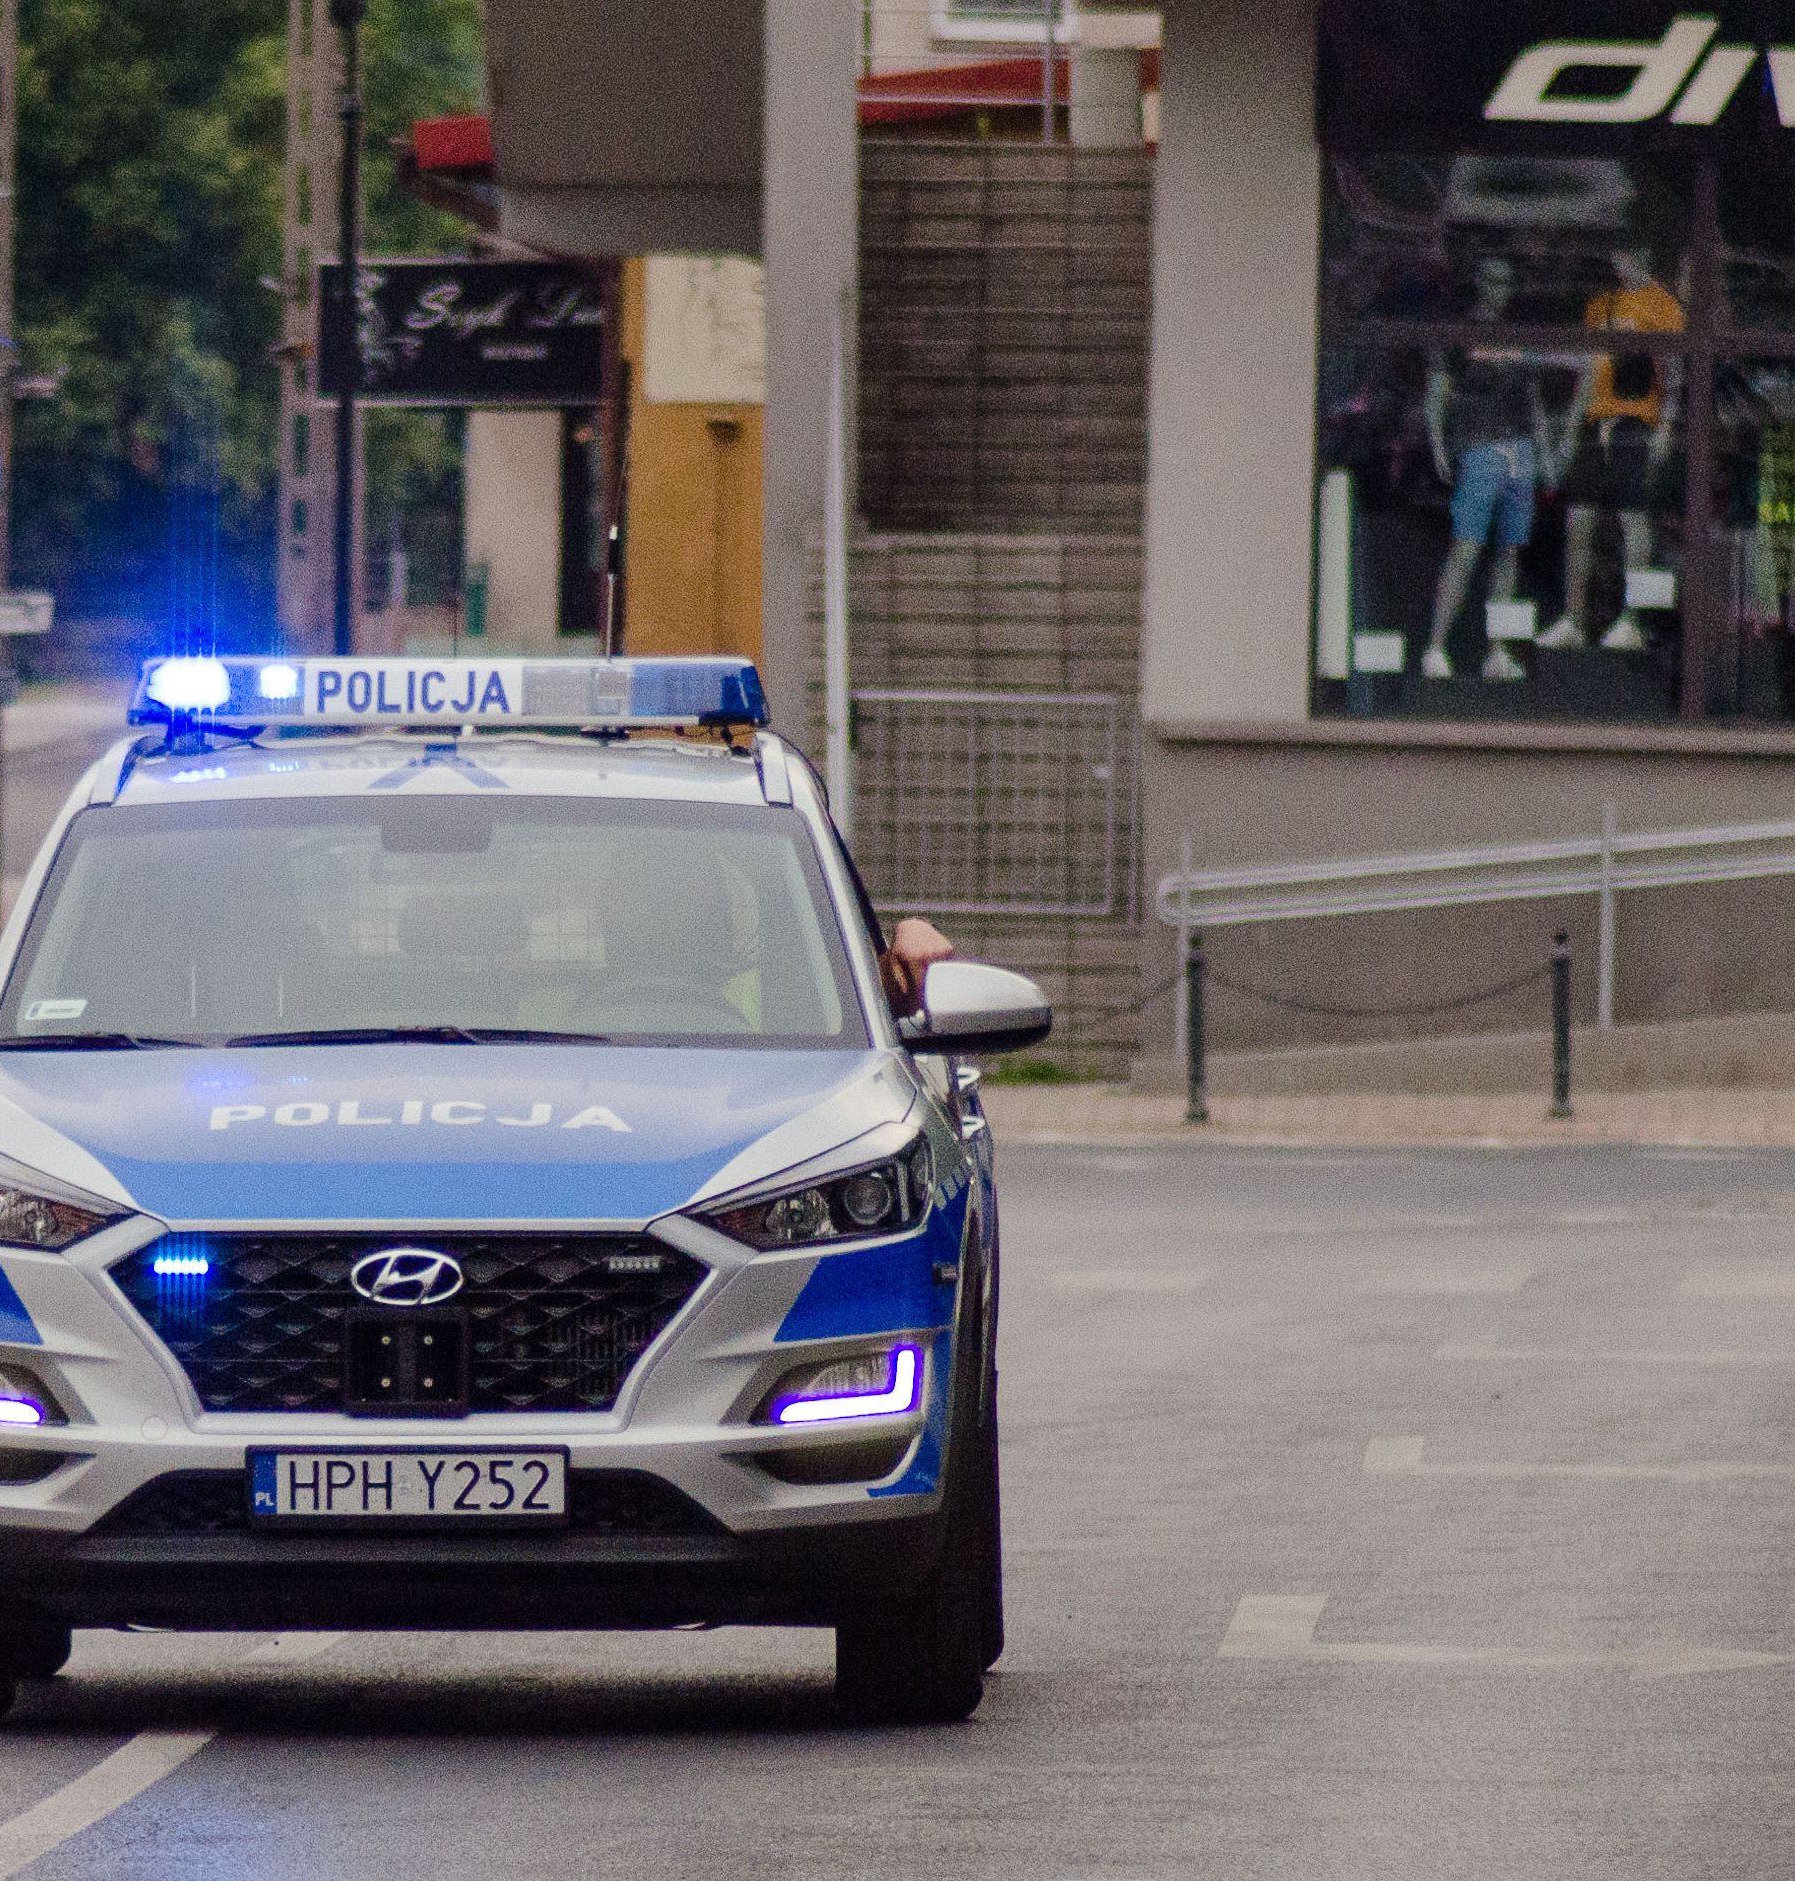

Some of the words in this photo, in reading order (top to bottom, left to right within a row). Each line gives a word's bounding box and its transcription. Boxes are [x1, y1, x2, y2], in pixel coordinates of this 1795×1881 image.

[1483, 16, 1795, 127] di
[317, 670, 511, 714] POLICJA
[208, 1101, 633, 1133] POLICJA
[255, 1491, 275, 1507] PL
[289, 1460, 393, 1511] HPH
[417, 1459, 550, 1511] Y252
